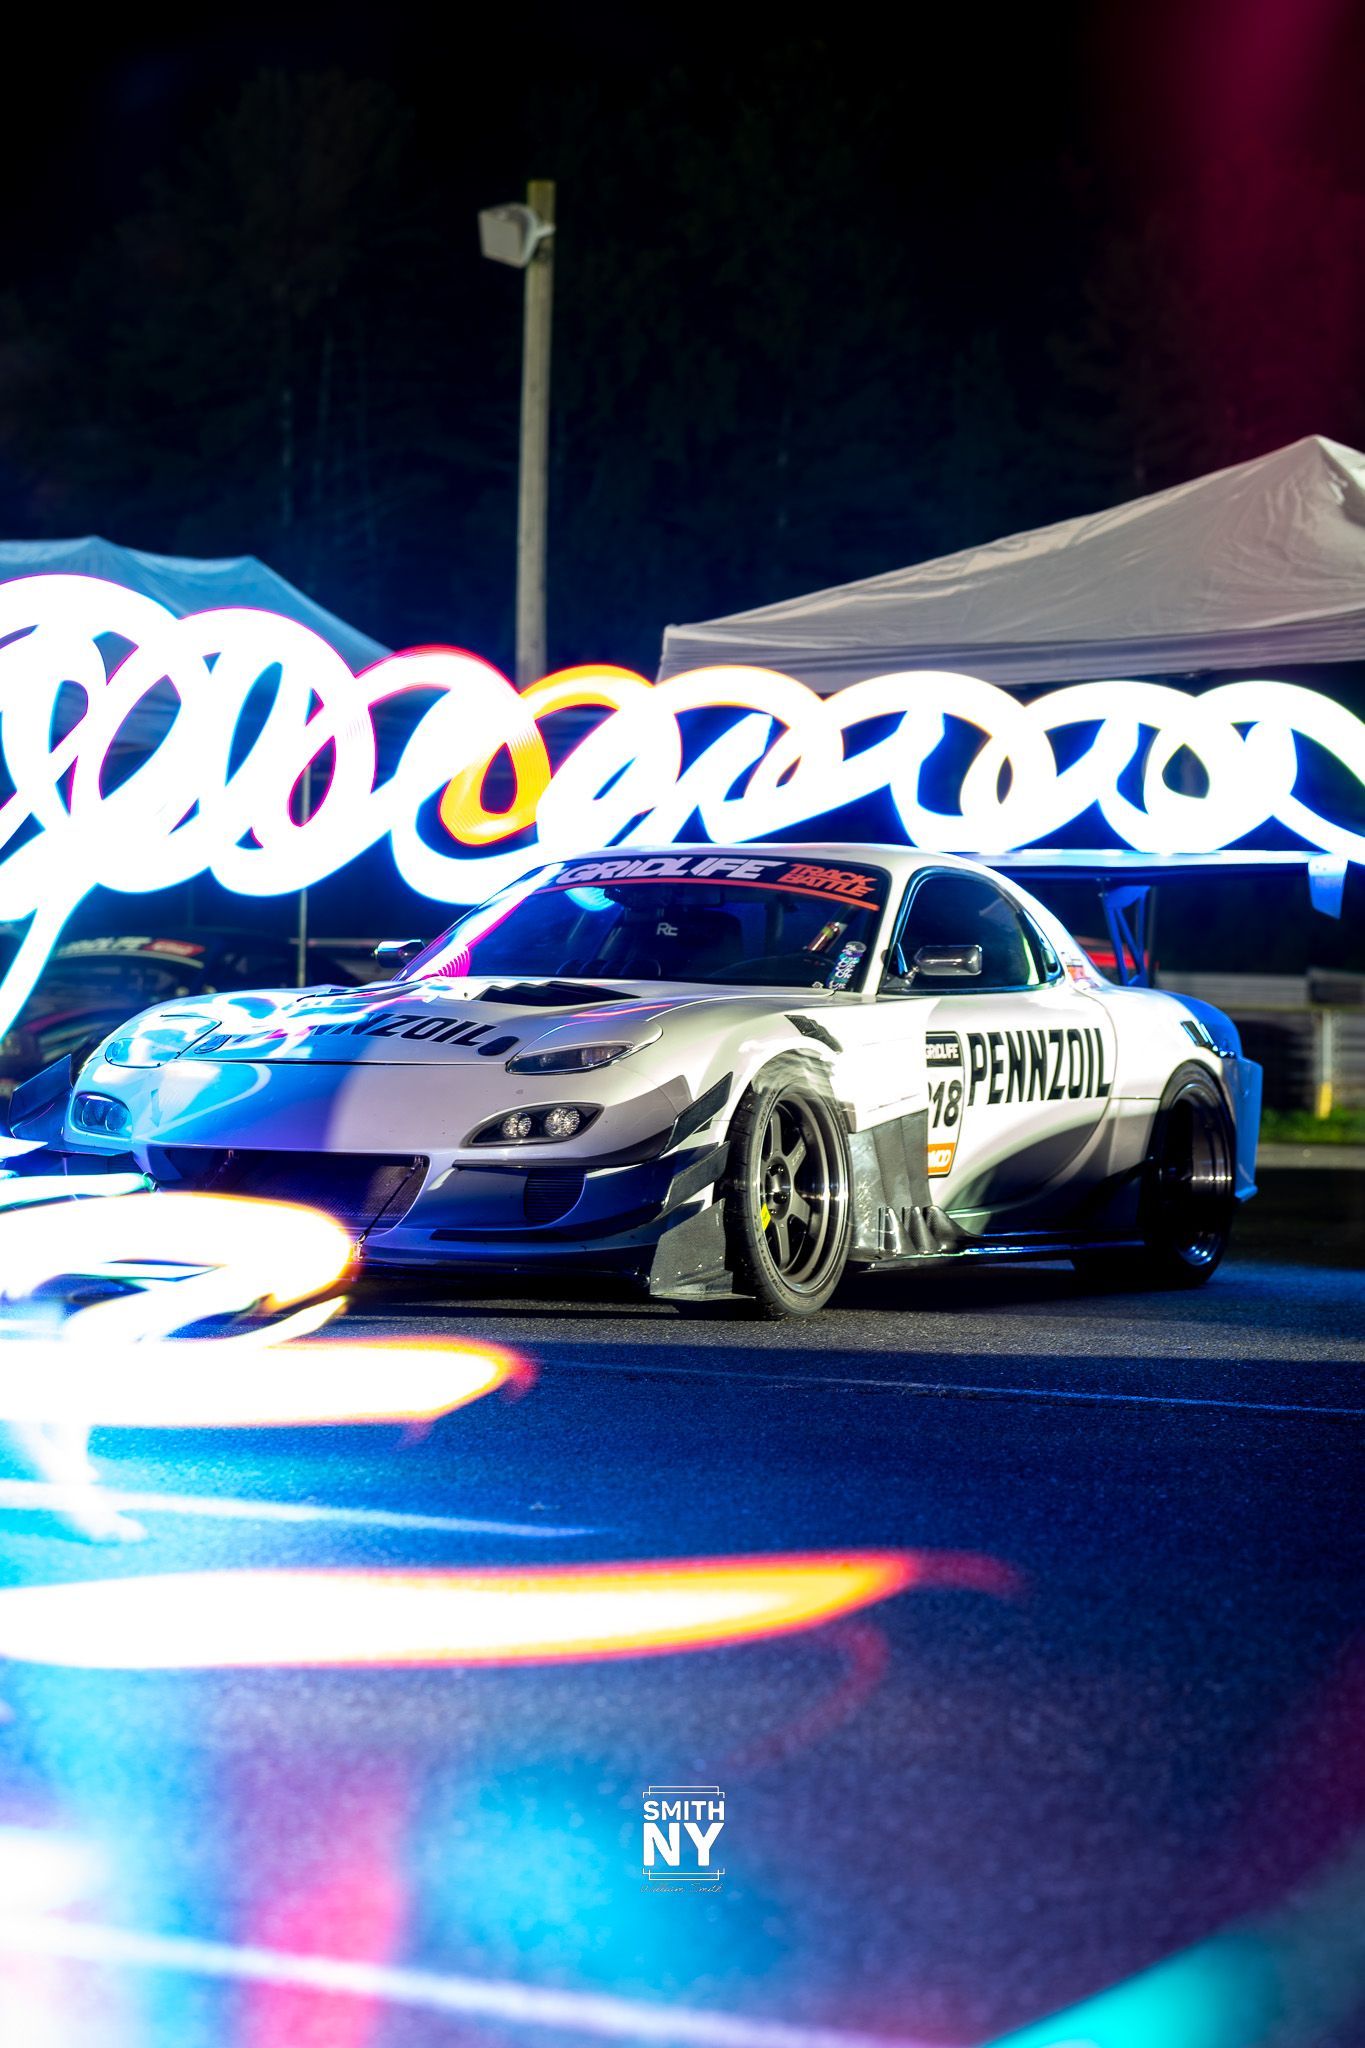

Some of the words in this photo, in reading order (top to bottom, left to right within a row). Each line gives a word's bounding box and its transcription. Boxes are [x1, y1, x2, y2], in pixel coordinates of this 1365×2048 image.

[555, 857, 786, 884] GRIDLIFE
[790, 863, 878, 886] TRACK
[777, 873, 876, 897] BATTLE
[966, 1028, 1111, 1106] PENNZOIL
[928, 1079, 962, 1128] 18
